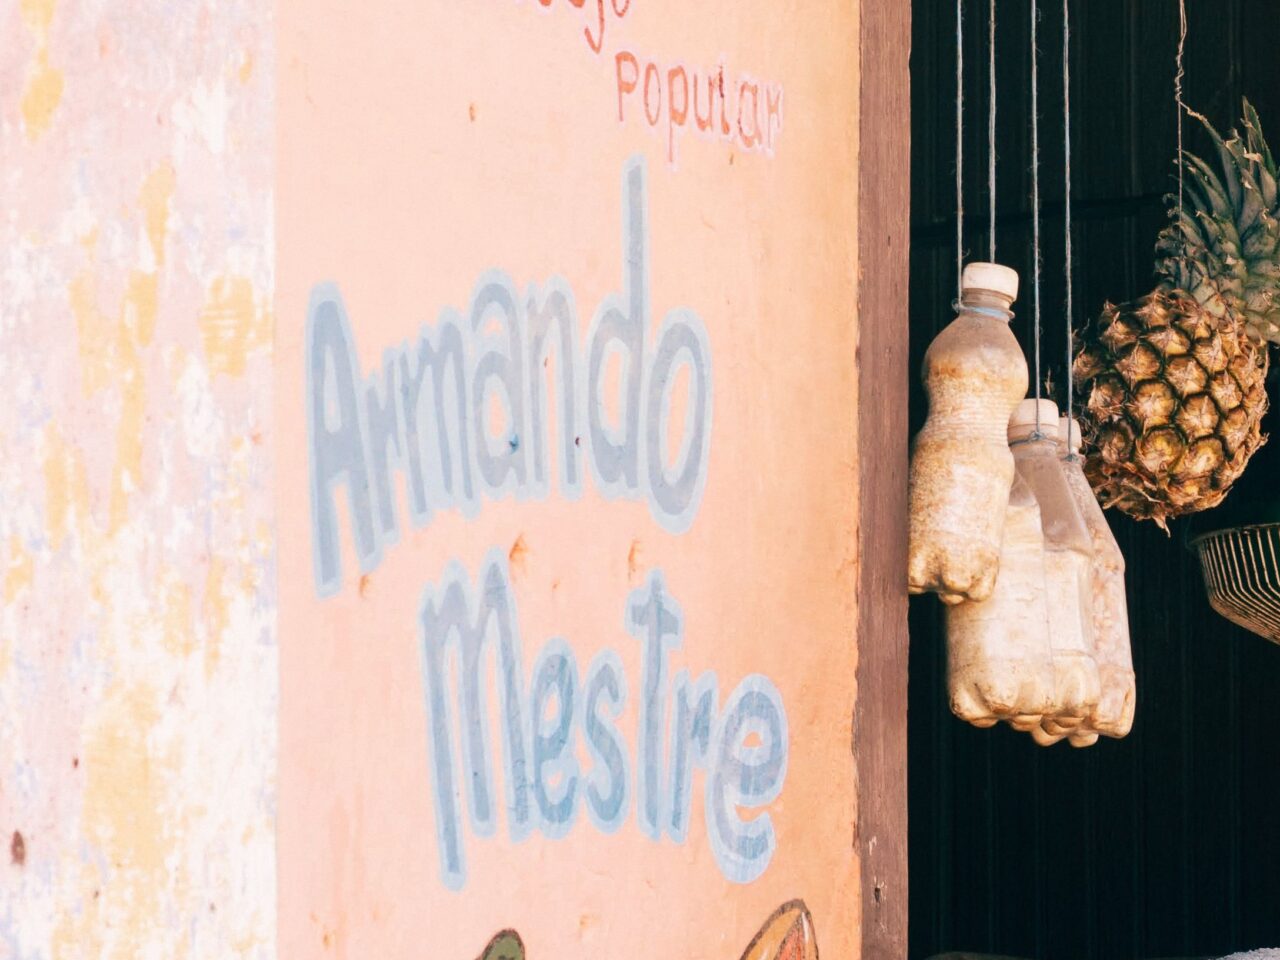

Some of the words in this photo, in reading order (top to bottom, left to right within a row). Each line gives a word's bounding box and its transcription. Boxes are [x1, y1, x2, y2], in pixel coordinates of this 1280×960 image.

[613, 49, 783, 166] Popular
[306, 154, 712, 598] Armando
[420, 548, 787, 891] Mestre
